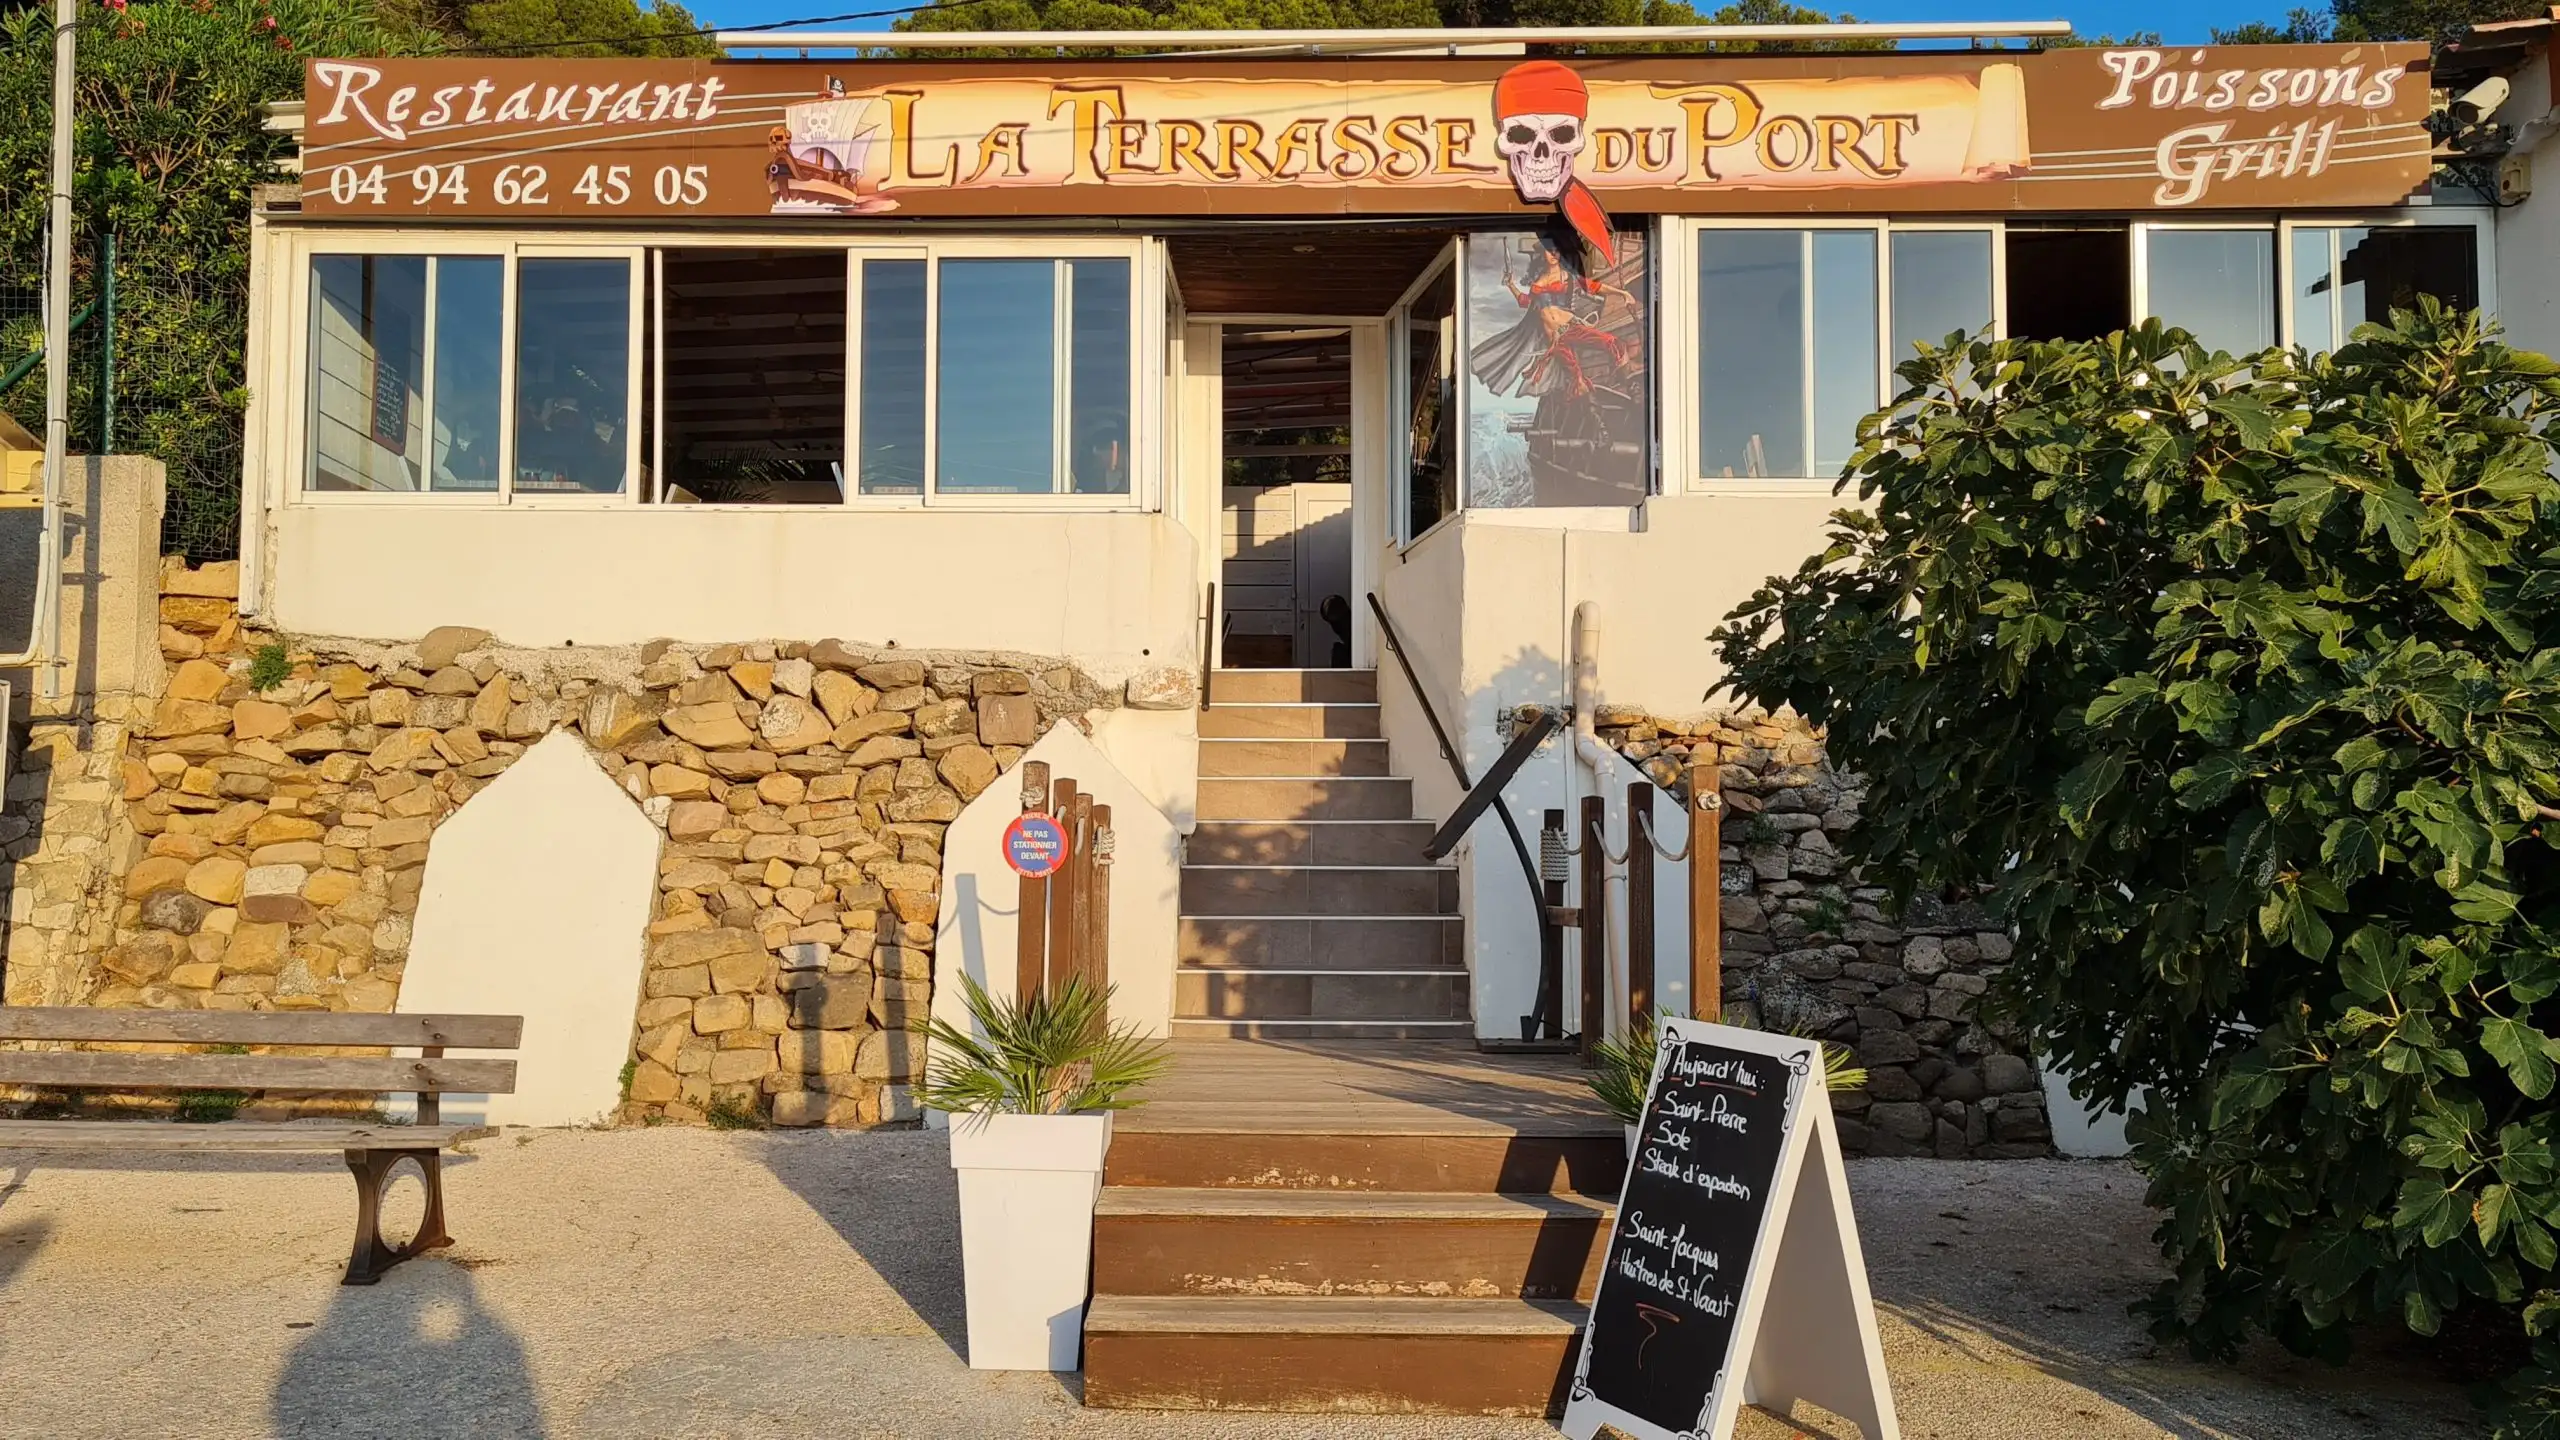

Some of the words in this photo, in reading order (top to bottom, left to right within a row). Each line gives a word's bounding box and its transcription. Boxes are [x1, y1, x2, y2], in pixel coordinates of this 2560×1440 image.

[2095, 47, 2406, 111] Poissons
[314, 61, 725, 141] Restaurant
[1046, 84, 1500, 187] TERRASSE
[1592, 126, 1676, 172] DU
[1648, 81, 1920, 187] PORT
[2154, 115, 2343, 206] Grill
[330, 164, 387, 205] 04
[412, 164, 469, 205] 94
[493, 164, 549, 205] 62
[572, 164, 630, 205] 45
[653, 164, 708, 205] 05
[1013, 840, 1057, 849] STATIONNER
[1022, 830, 1033, 838] NE
[1034, 830, 1048, 838] PAS
[1020, 851, 1049, 860] DEVANT
[1652, 1120, 1691, 1151] Sole
[1643, 1148, 1679, 1178] Steak
[1683, 1164, 1750, 1201] d'espadon
[1658, 1269, 1674, 1295] de
